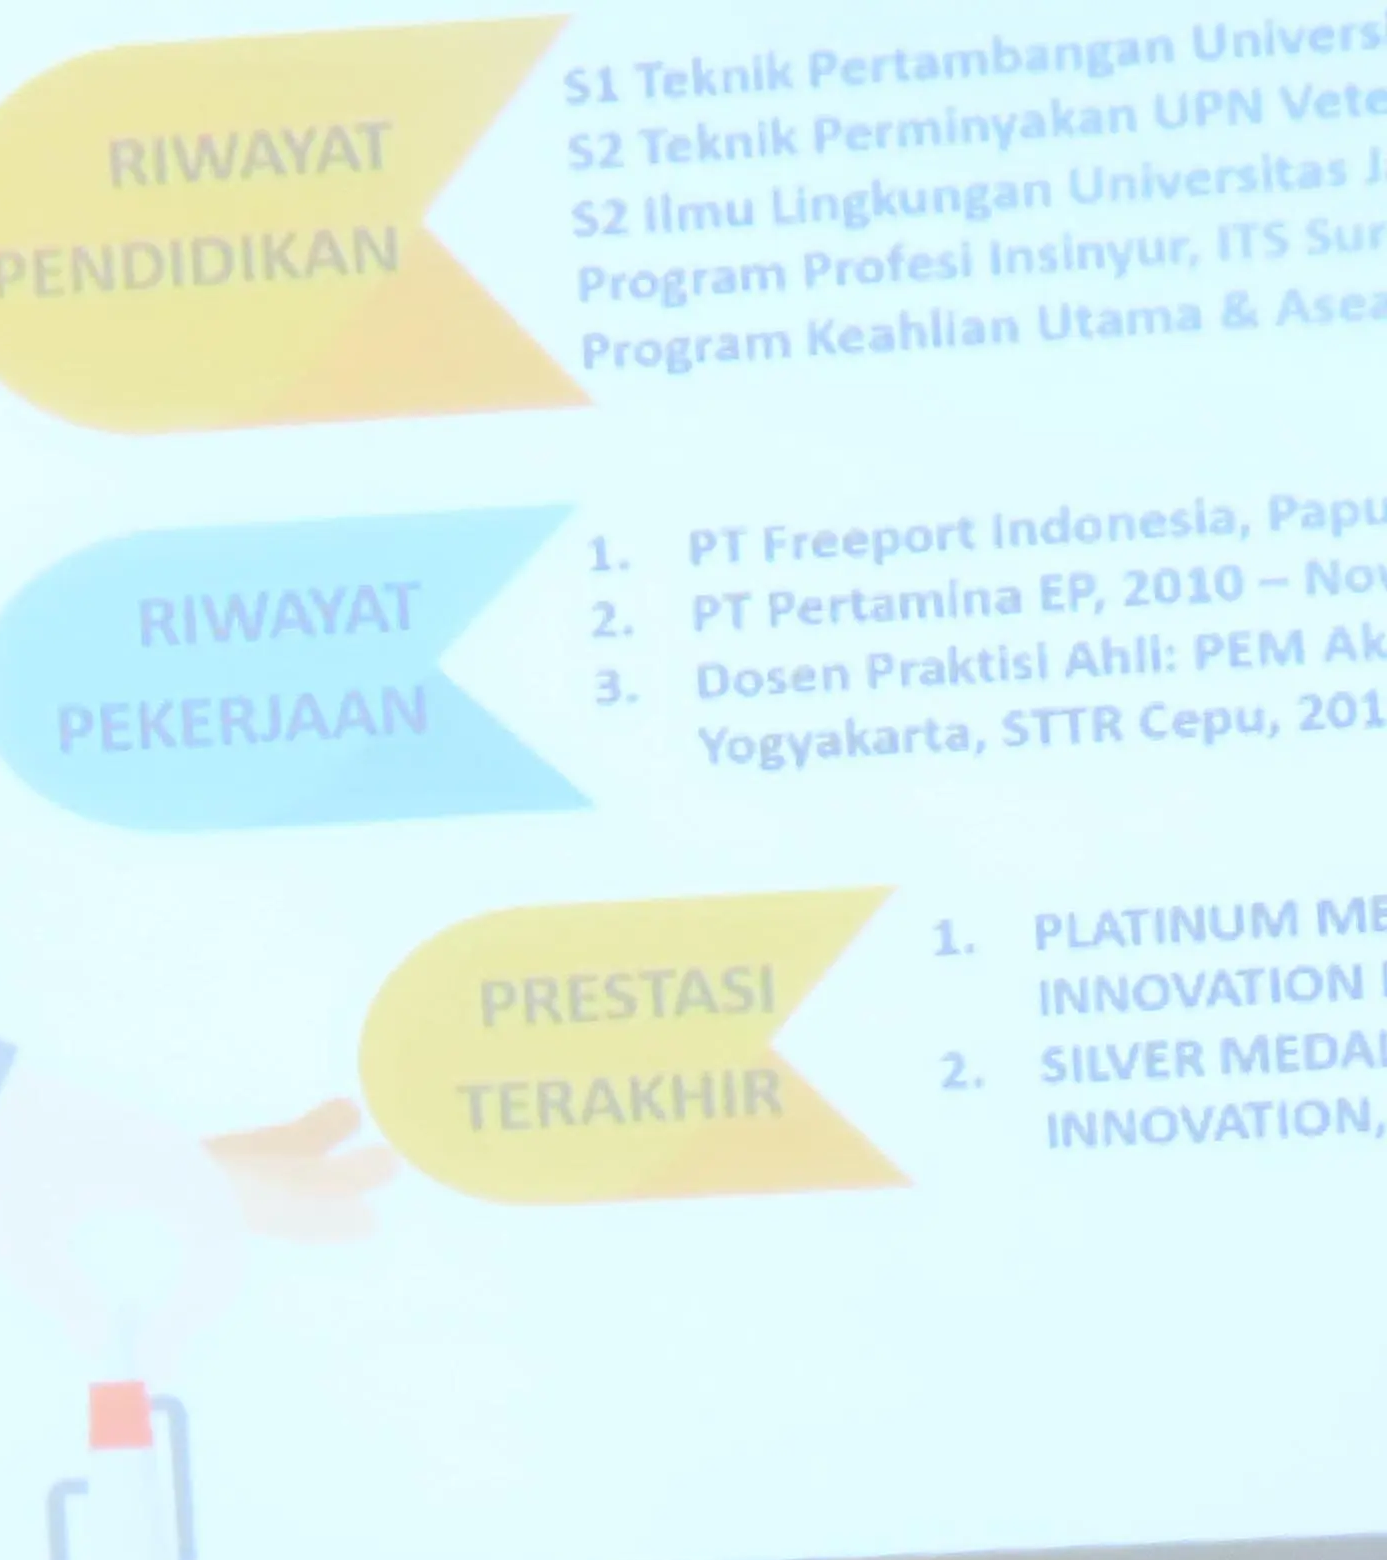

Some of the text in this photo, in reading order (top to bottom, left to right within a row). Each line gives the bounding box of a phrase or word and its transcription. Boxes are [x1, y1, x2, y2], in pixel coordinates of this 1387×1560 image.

[566, 68, 617, 104] S1
[636, 53, 792, 98] Teknik
[810, 37, 1173, 87] Pertambangan
[111, 122, 390, 187] RIWAYAT
[570, 133, 622, 169] S2
[641, 119, 796, 163] Teknik
[815, 99, 1135, 153] Perminyakan
[1156, 89, 1261, 129] UPN
[574, 200, 626, 236] S2
[646, 194, 753, 231] Ilmu
[774, 180, 1050, 229] Lingkungan
[1071, 155, 1346, 203] Universitas
[580, 262, 786, 307] Program
[806, 243, 971, 287] Profesi
[992, 234, 1197, 278] Insinyur,
[1220, 222, 1288, 259] ITS
[584, 333, 790, 374] Program
[809, 309, 1018, 355] Keahlian
[1040, 305, 1201, 340] Utama
[1223, 292, 1257, 328] &
[592, 496, 1387, 571] 1. PT Freeport Indonesia, Papu
[141, 582, 420, 646] RIWAYAT
[594, 602, 632, 637] 2.
[695, 593, 750, 631] PT
[770, 580, 1020, 626] Pertamina
[1042, 574, 1103, 613] EP,
[1126, 566, 1243, 605] 2010
[598, 670, 637, 705] 3.
[699, 664, 848, 698] Dosen
[869, 643, 1046, 688] Praktisi
[1066, 636, 1174, 677] Ahli:
[1196, 631, 1303, 669] PEM
[60, 685, 429, 753] PEKERJAAN
[700, 691, 1387, 770] Yogyakarta, STTR Cepu, 201
[936, 921, 973, 955] 1.
[1037, 901, 1297, 949] PLATINUM
[482, 966, 772, 1026] PRESTASI
[1041, 965, 1362, 1015] INNOVATION
[943, 1053, 982, 1089] 2.
[1043, 1041, 1203, 1083] SILVER
[458, 1070, 781, 1130] TERAKHIR
[1049, 1099, 1387, 1147] INNOVATION,
